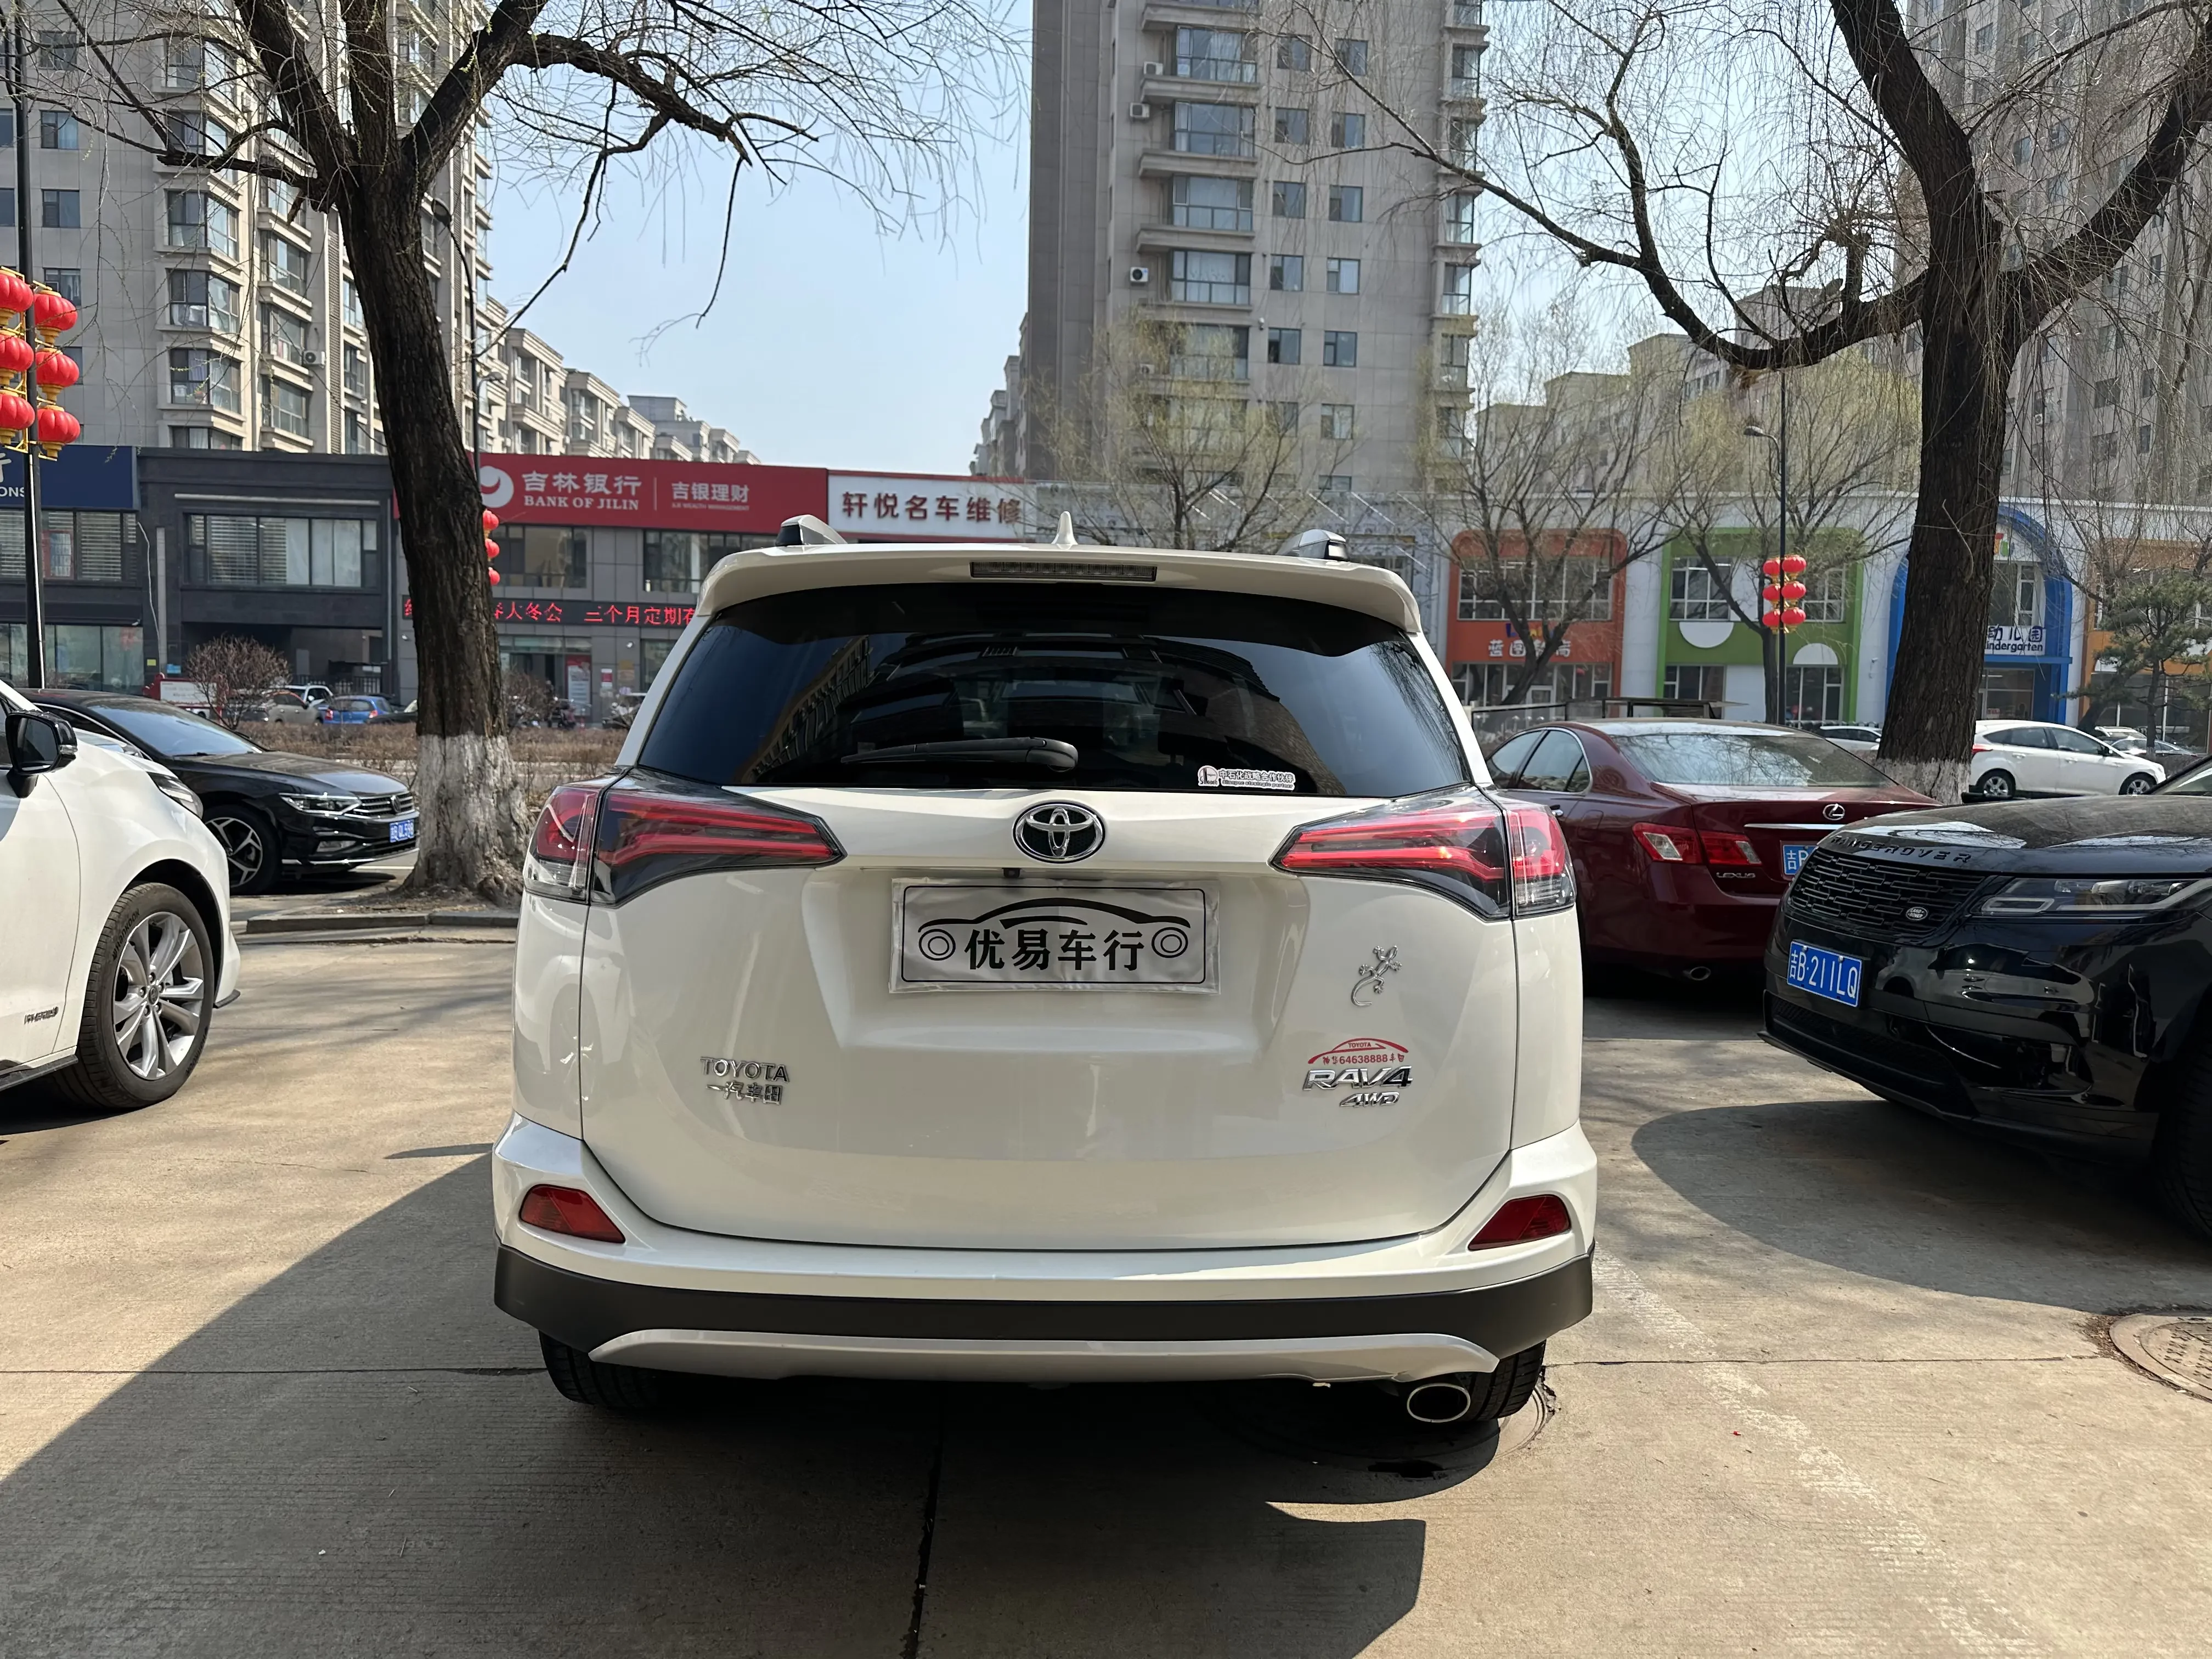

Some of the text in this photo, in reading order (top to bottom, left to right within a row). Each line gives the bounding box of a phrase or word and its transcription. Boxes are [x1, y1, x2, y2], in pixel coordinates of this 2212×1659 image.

[522, 470, 642, 495] 吉林银行
[672, 482, 749, 503] 吉银理财
[524, 495, 639, 510] BANK OF JILIN
[842, 492, 1021, 523] 轩悦名车维修
[1985, 640, 2043, 652] indergarten
[1219, 770, 1294, 783] 中石化战略合作伙伴
[964, 929, 1145, 971] 优易车行
[700, 1057, 790, 1083] TOYOTA
[1302, 1066, 1413, 1091] RAV4
[1340, 1091, 1400, 1108] 4WD
